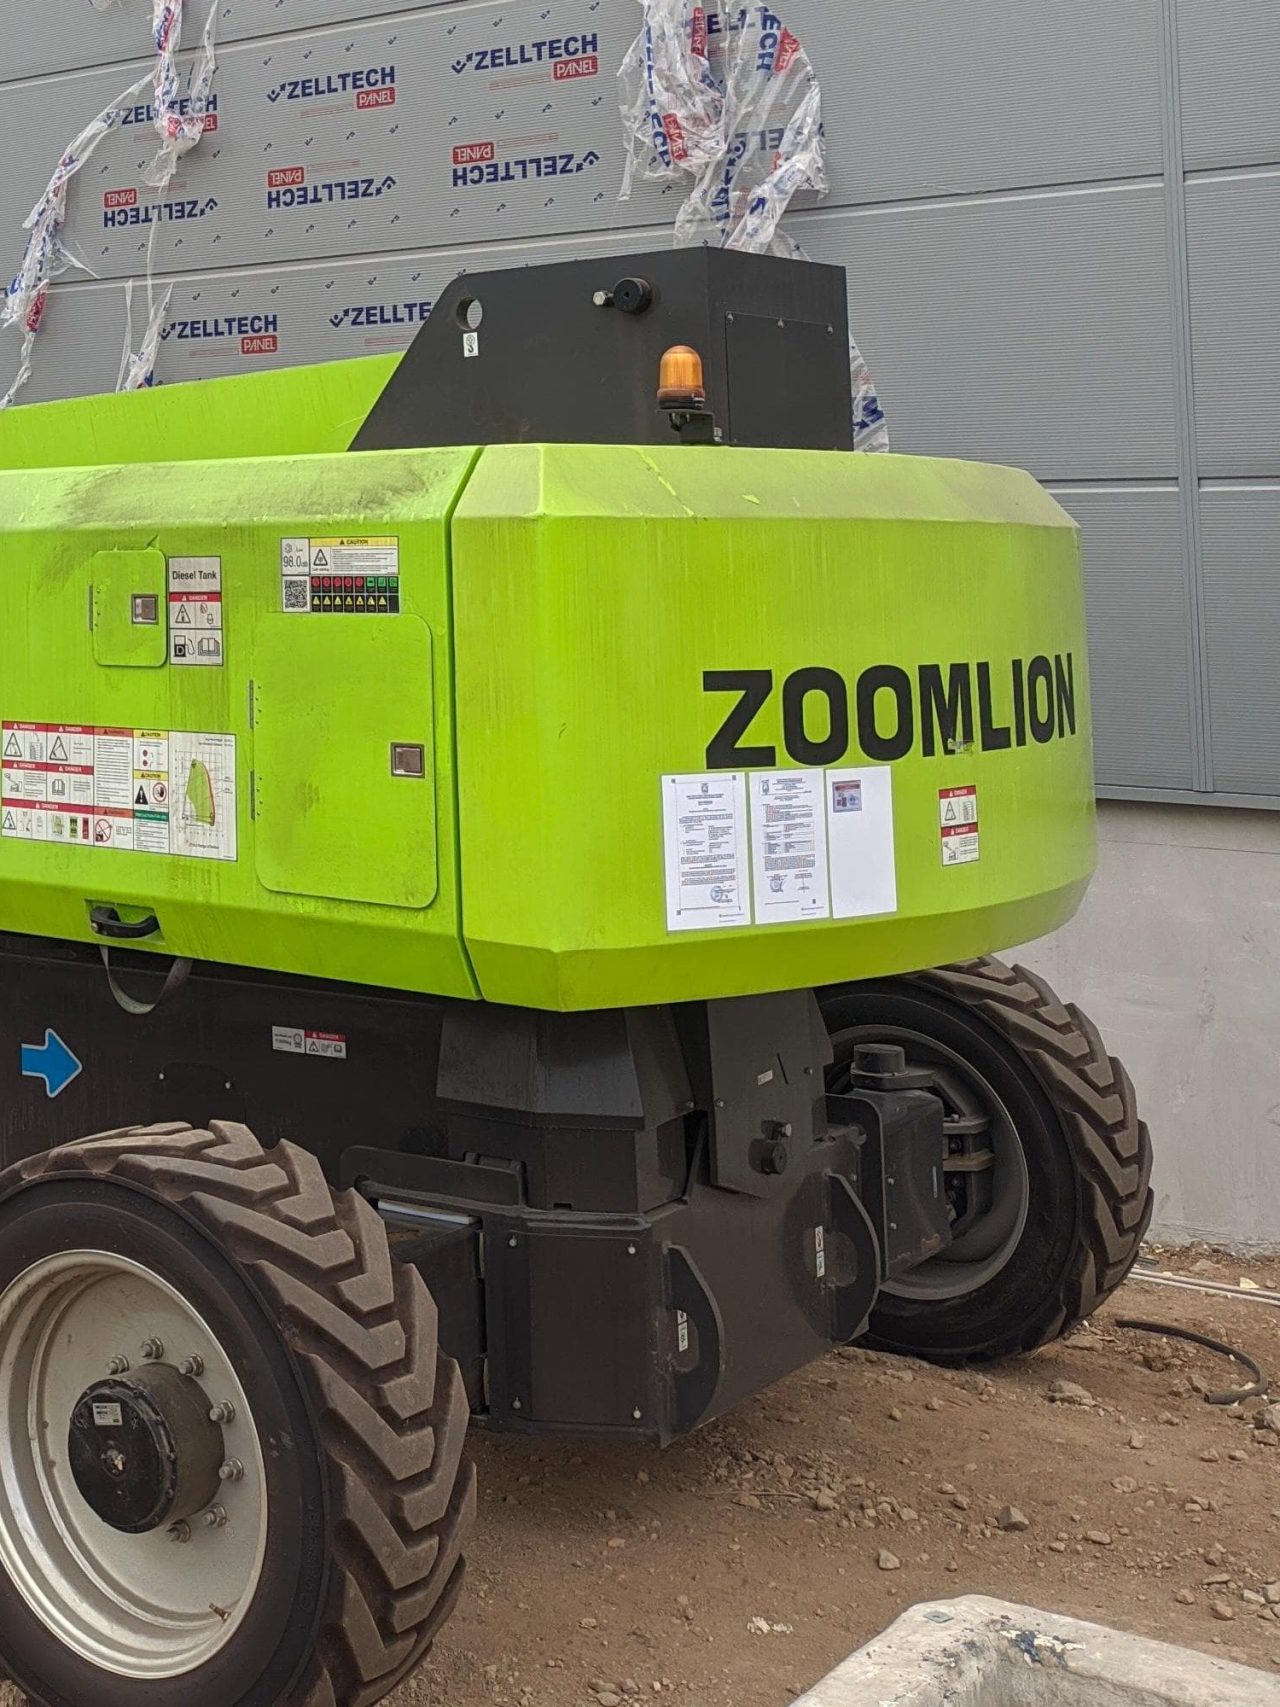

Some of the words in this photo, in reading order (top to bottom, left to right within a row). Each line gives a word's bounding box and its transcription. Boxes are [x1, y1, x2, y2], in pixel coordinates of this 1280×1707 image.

[475, 34, 598, 71] ZELLTECH
[557, 58, 595, 77] PANEL
[288, 66, 396, 100] ZELLTECH
[359, 90, 394, 107] PANEL
[455, 144, 493, 161] PANEL
[269, 169, 303, 185] PANEL
[452, 153, 574, 188] ZELLTECH
[106, 190, 135, 206] PANEL
[267, 178, 375, 209] ZELLTECH
[104, 200, 198, 227] ZELLTECH
[351, 302, 432, 326] ZELLTE
[178, 314, 278, 340] ZELLTECH
[244, 337, 276, 353] PANEL
[172, 571, 196, 580] Diesel
[198, 571, 217, 580] Tank
[702, 652, 1077, 770] ZOOMLION
